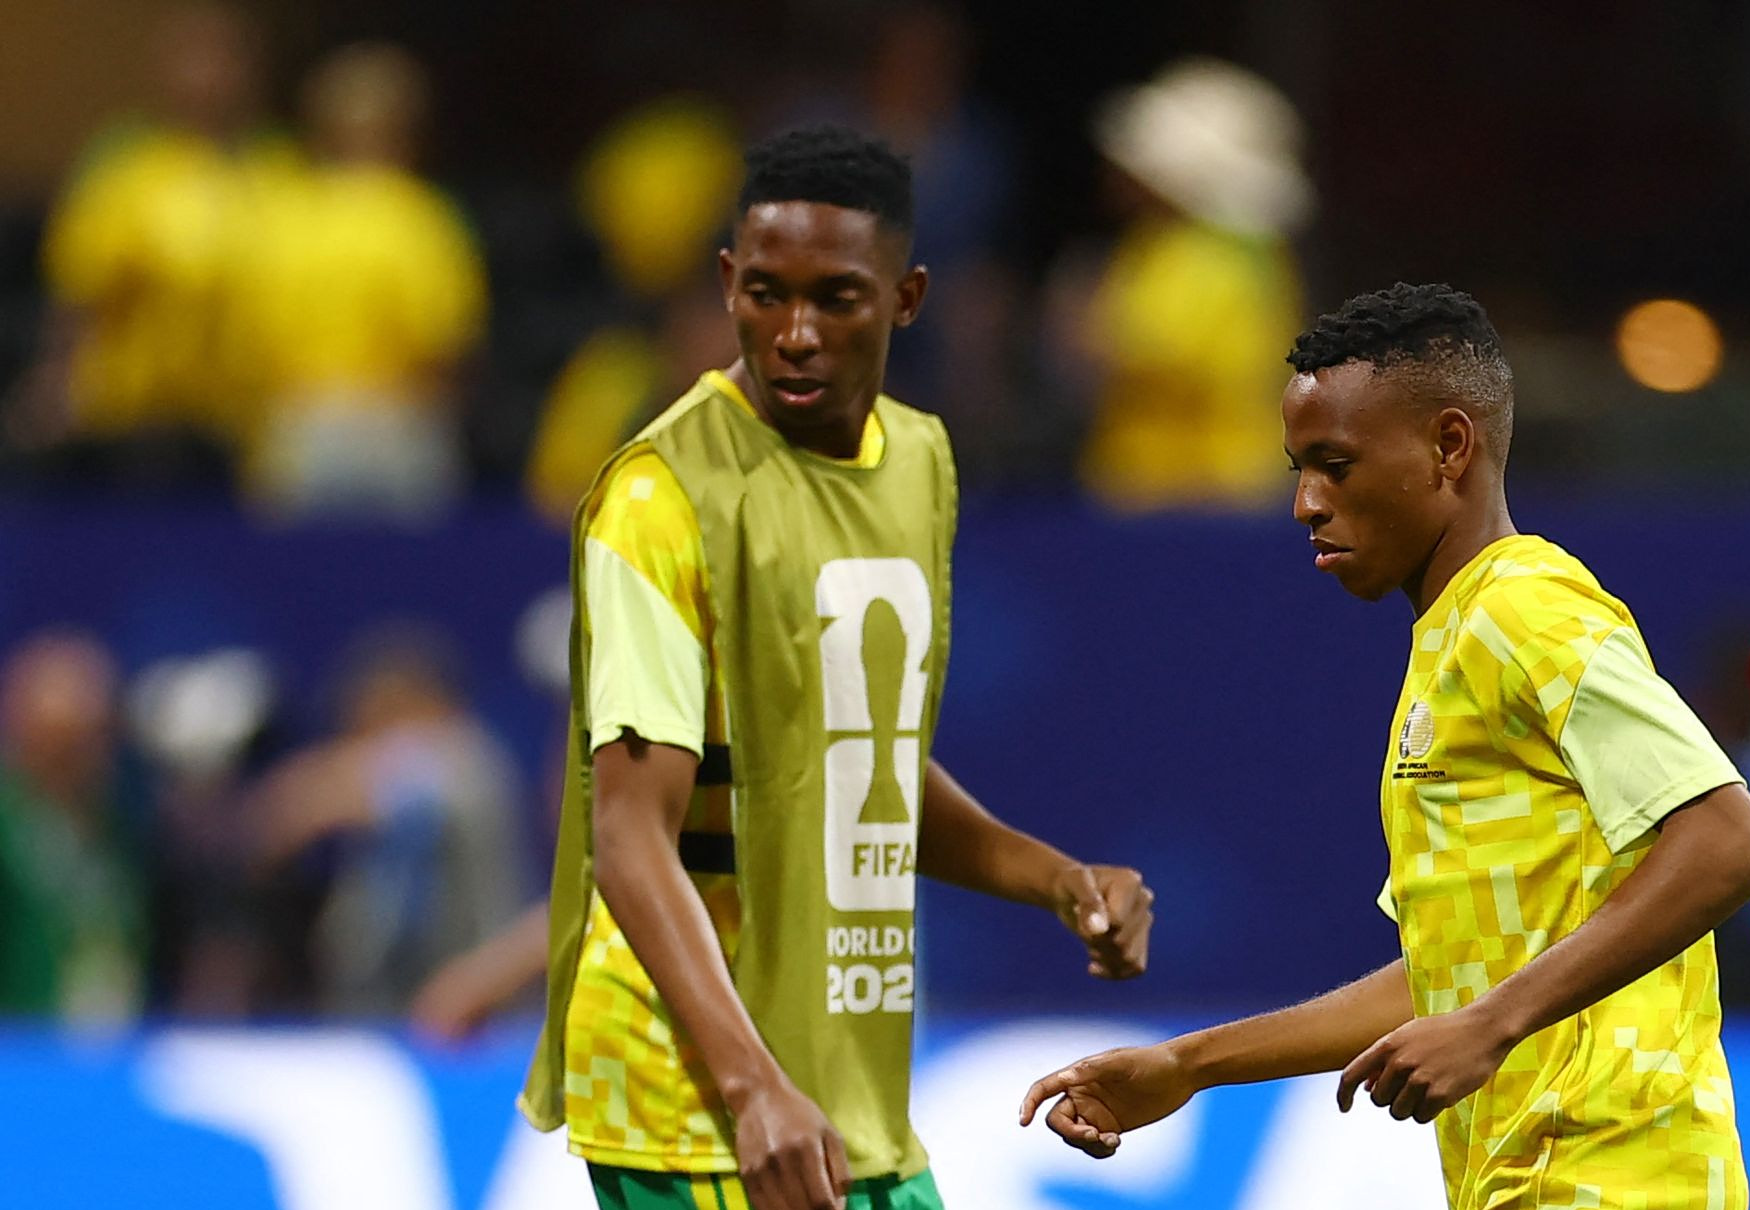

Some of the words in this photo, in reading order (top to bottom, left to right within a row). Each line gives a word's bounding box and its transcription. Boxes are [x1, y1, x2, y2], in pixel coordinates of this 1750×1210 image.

[853, 843, 914, 877] FIFA
[827, 926, 904, 958] ORLD
[827, 963, 915, 1014] 202
